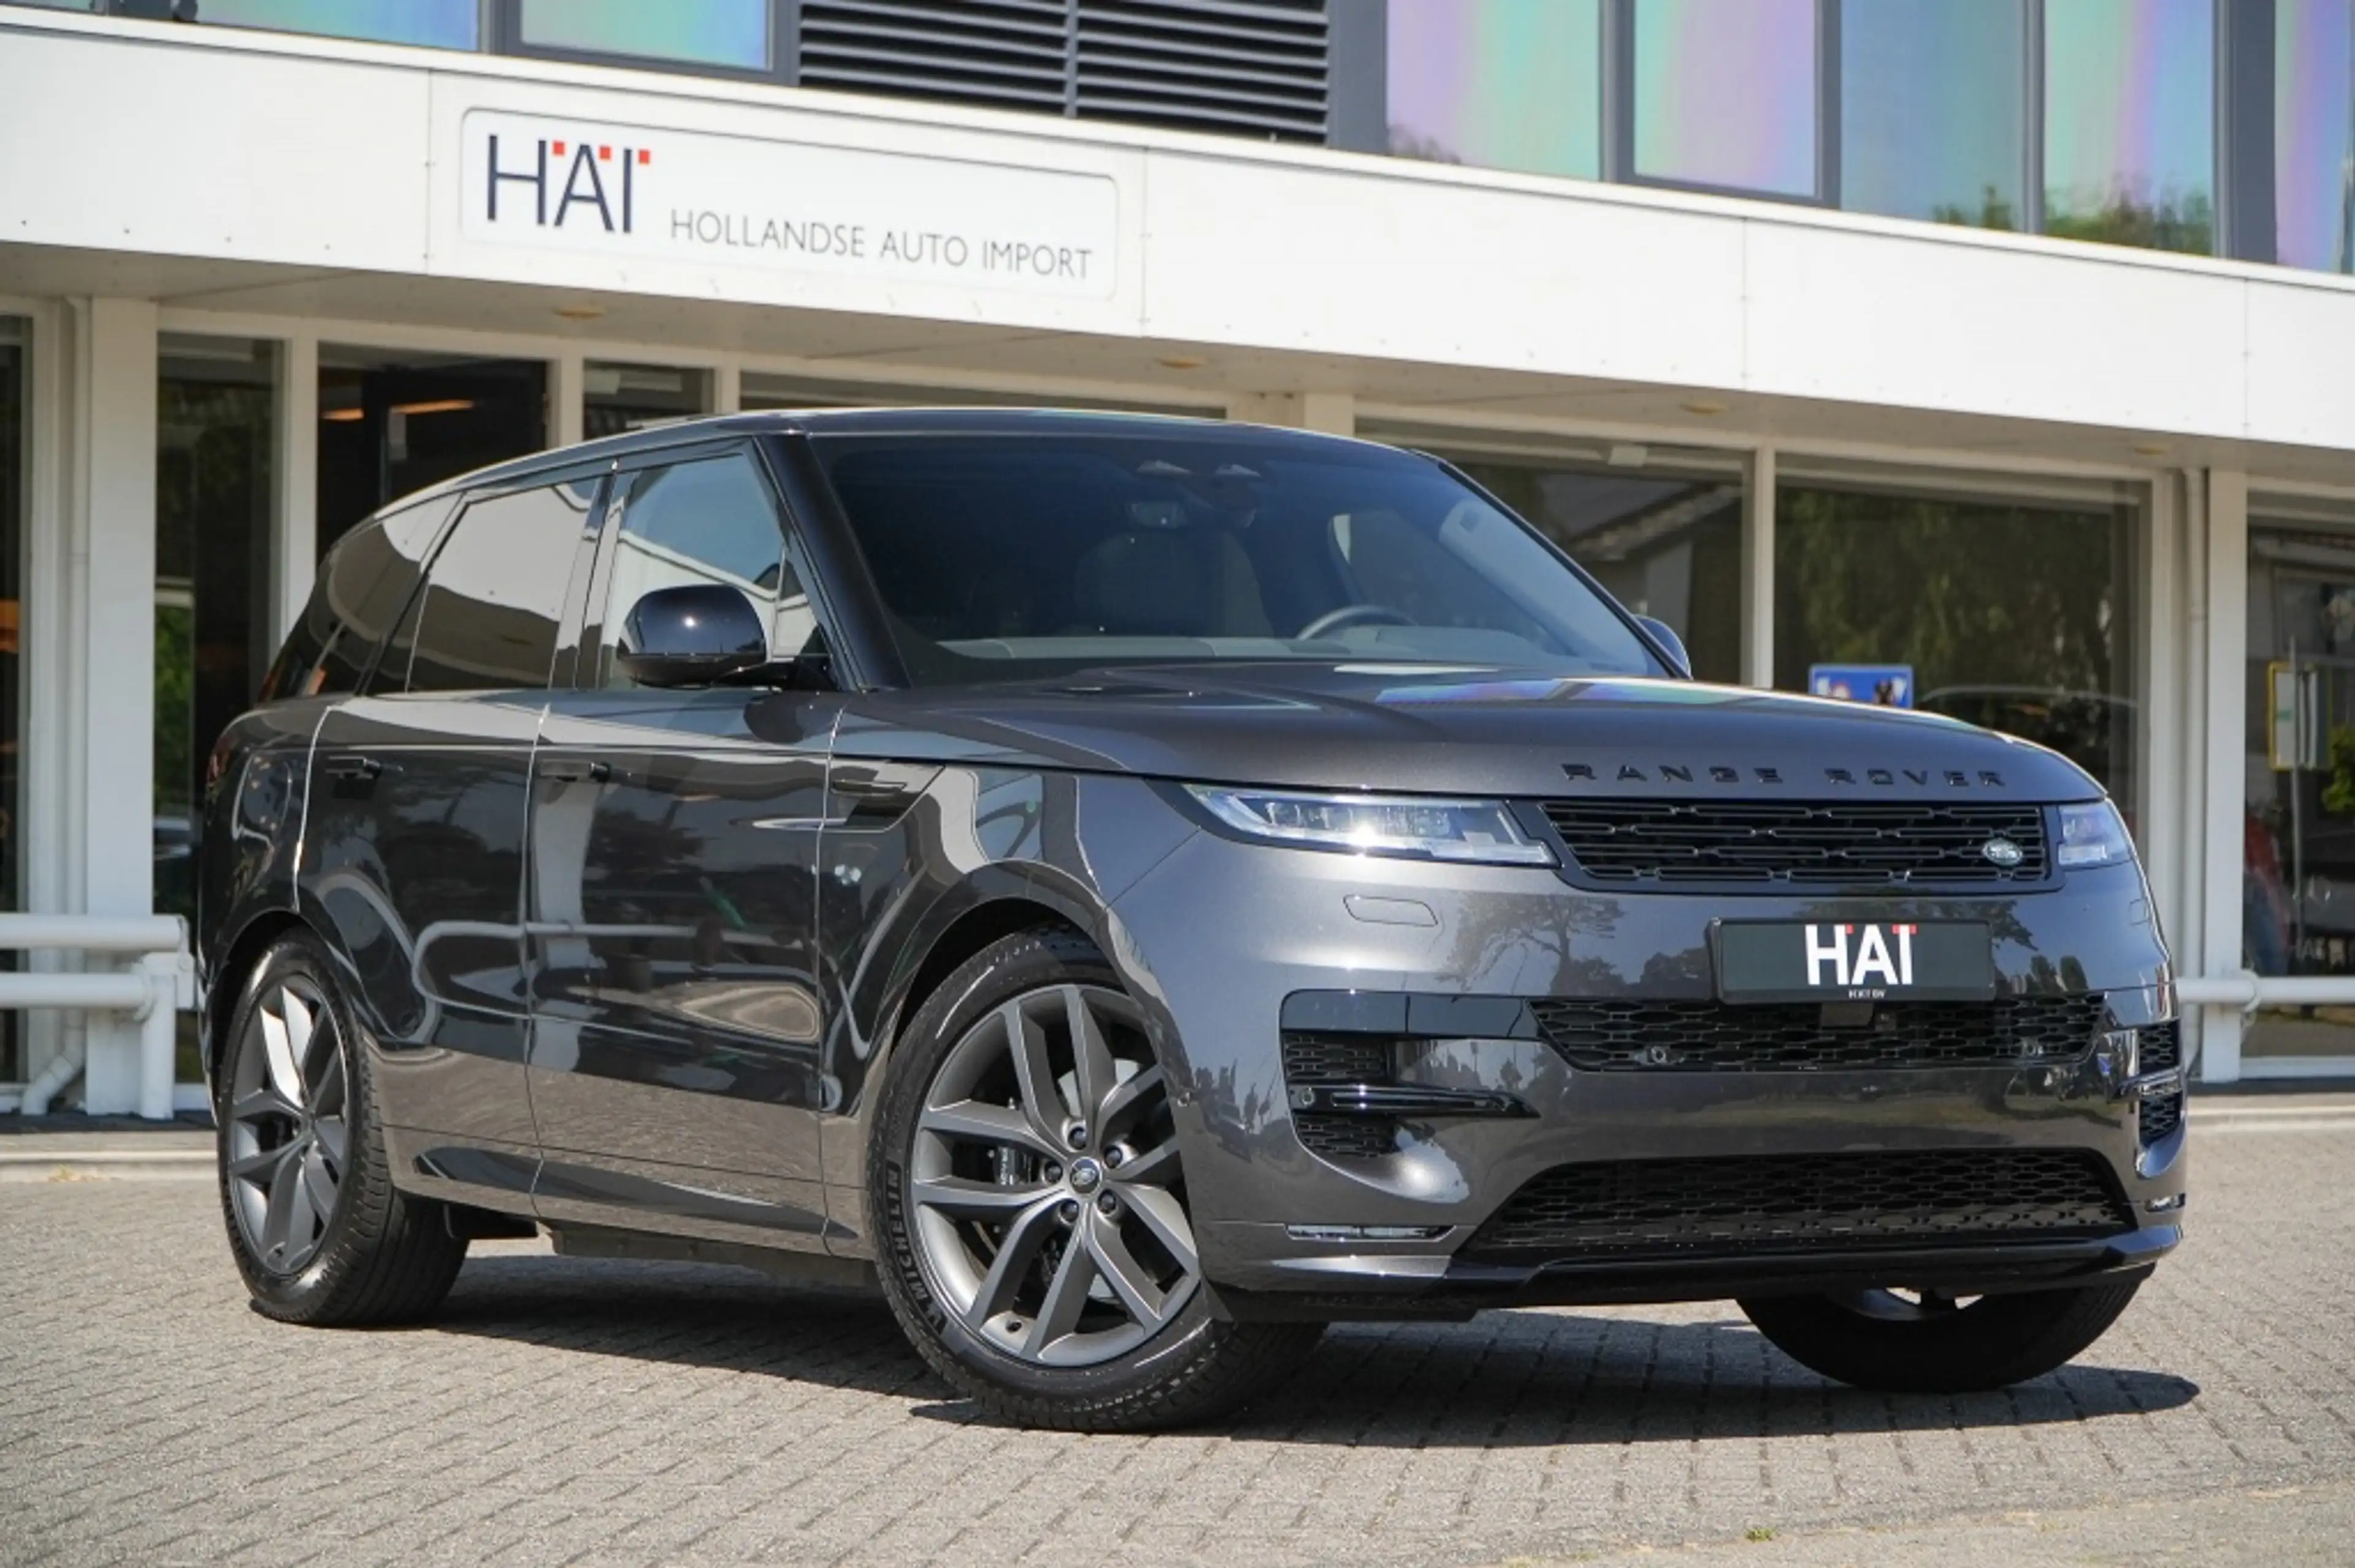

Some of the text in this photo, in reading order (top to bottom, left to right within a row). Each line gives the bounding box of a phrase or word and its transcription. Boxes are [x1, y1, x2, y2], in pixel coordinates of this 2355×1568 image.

[671, 208, 1093, 280] HOLLANDSE AUTO IMPORT
[1561, 763, 2005, 787] RANGE ROVER
[887, 1167, 929, 1301] MICHELIN
